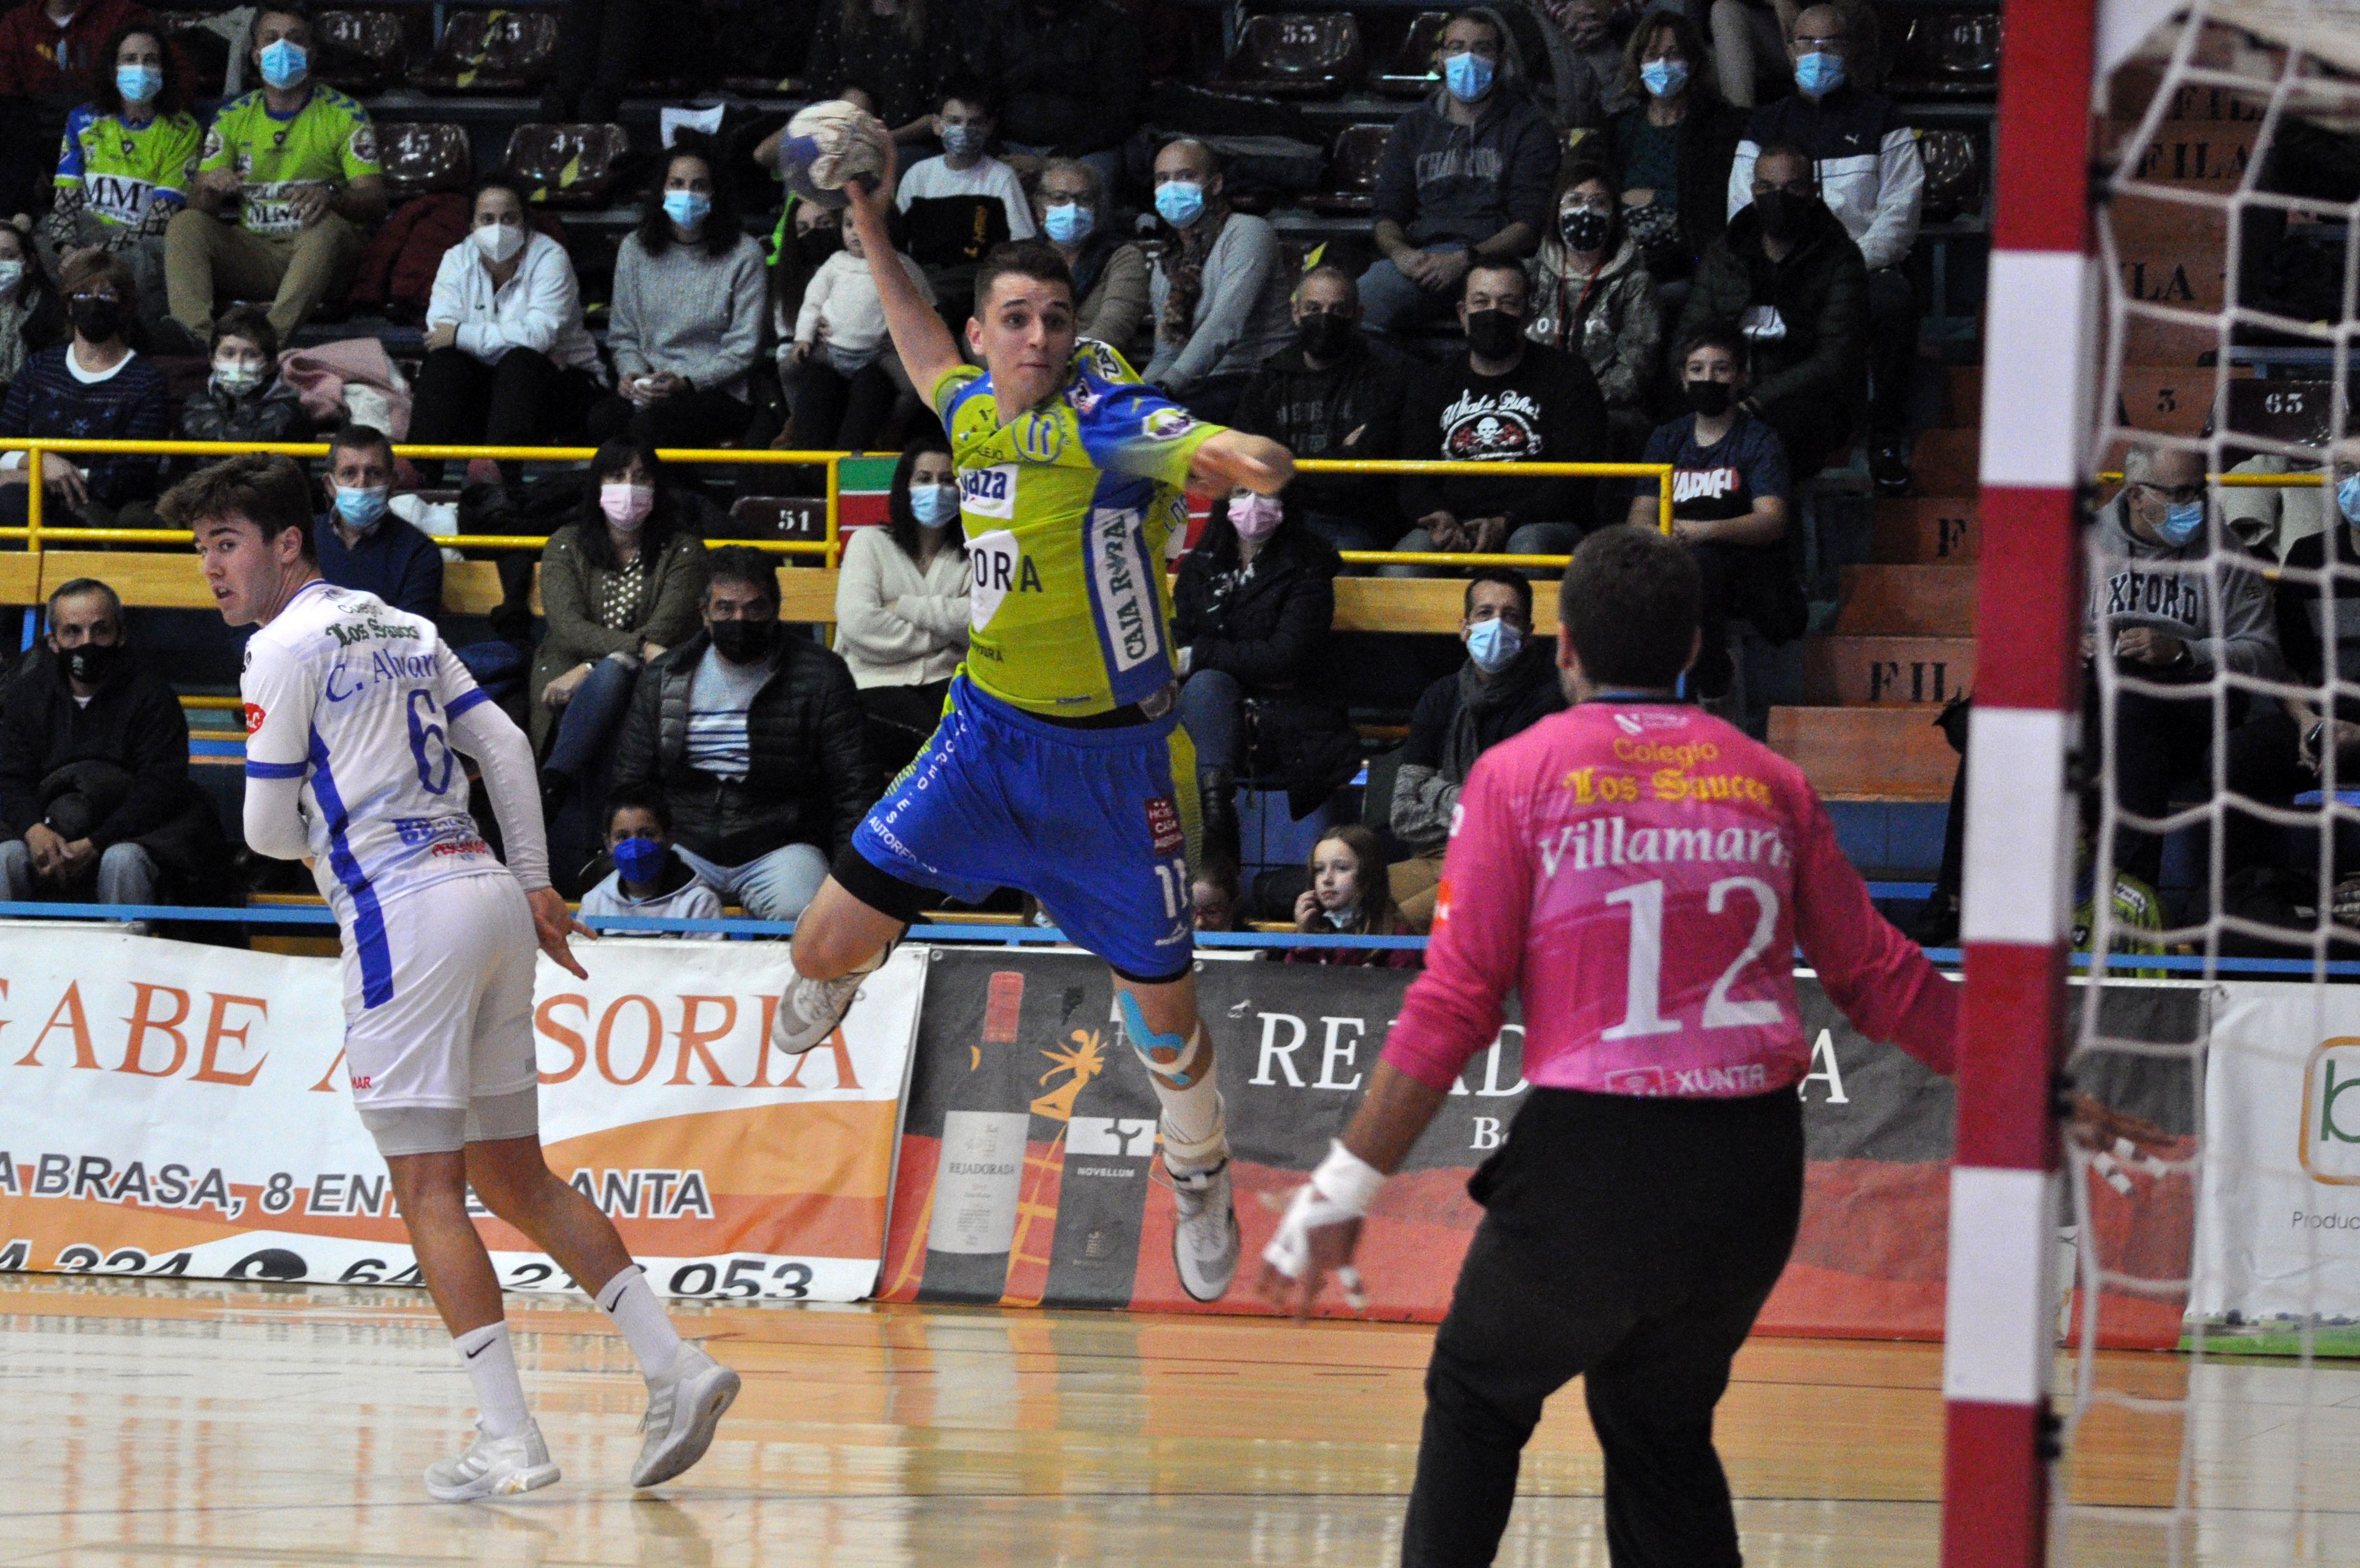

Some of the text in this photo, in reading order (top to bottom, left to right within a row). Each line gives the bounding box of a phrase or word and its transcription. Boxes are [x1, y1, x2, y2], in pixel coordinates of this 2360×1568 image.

[777, 510, 809, 532] 51
[974, 548, 1044, 594] ORA
[2091, 571, 2198, 626] XFORD
[326, 663, 364, 702] C.
[1870, 661, 1964, 703] FIL
[407, 688, 454, 795] 6
[1614, 737, 1718, 769] Colegio
[1562, 767, 1640, 806] Los
[1154, 859, 1188, 918] 11
[1601, 876, 1784, 1041] 12
[34, 1153, 245, 1221] BRASA,
[264, 1172, 293, 1211] 8
[2292, 1210, 2360, 1231] Produc
[669, 1258, 813, 1299] 053
